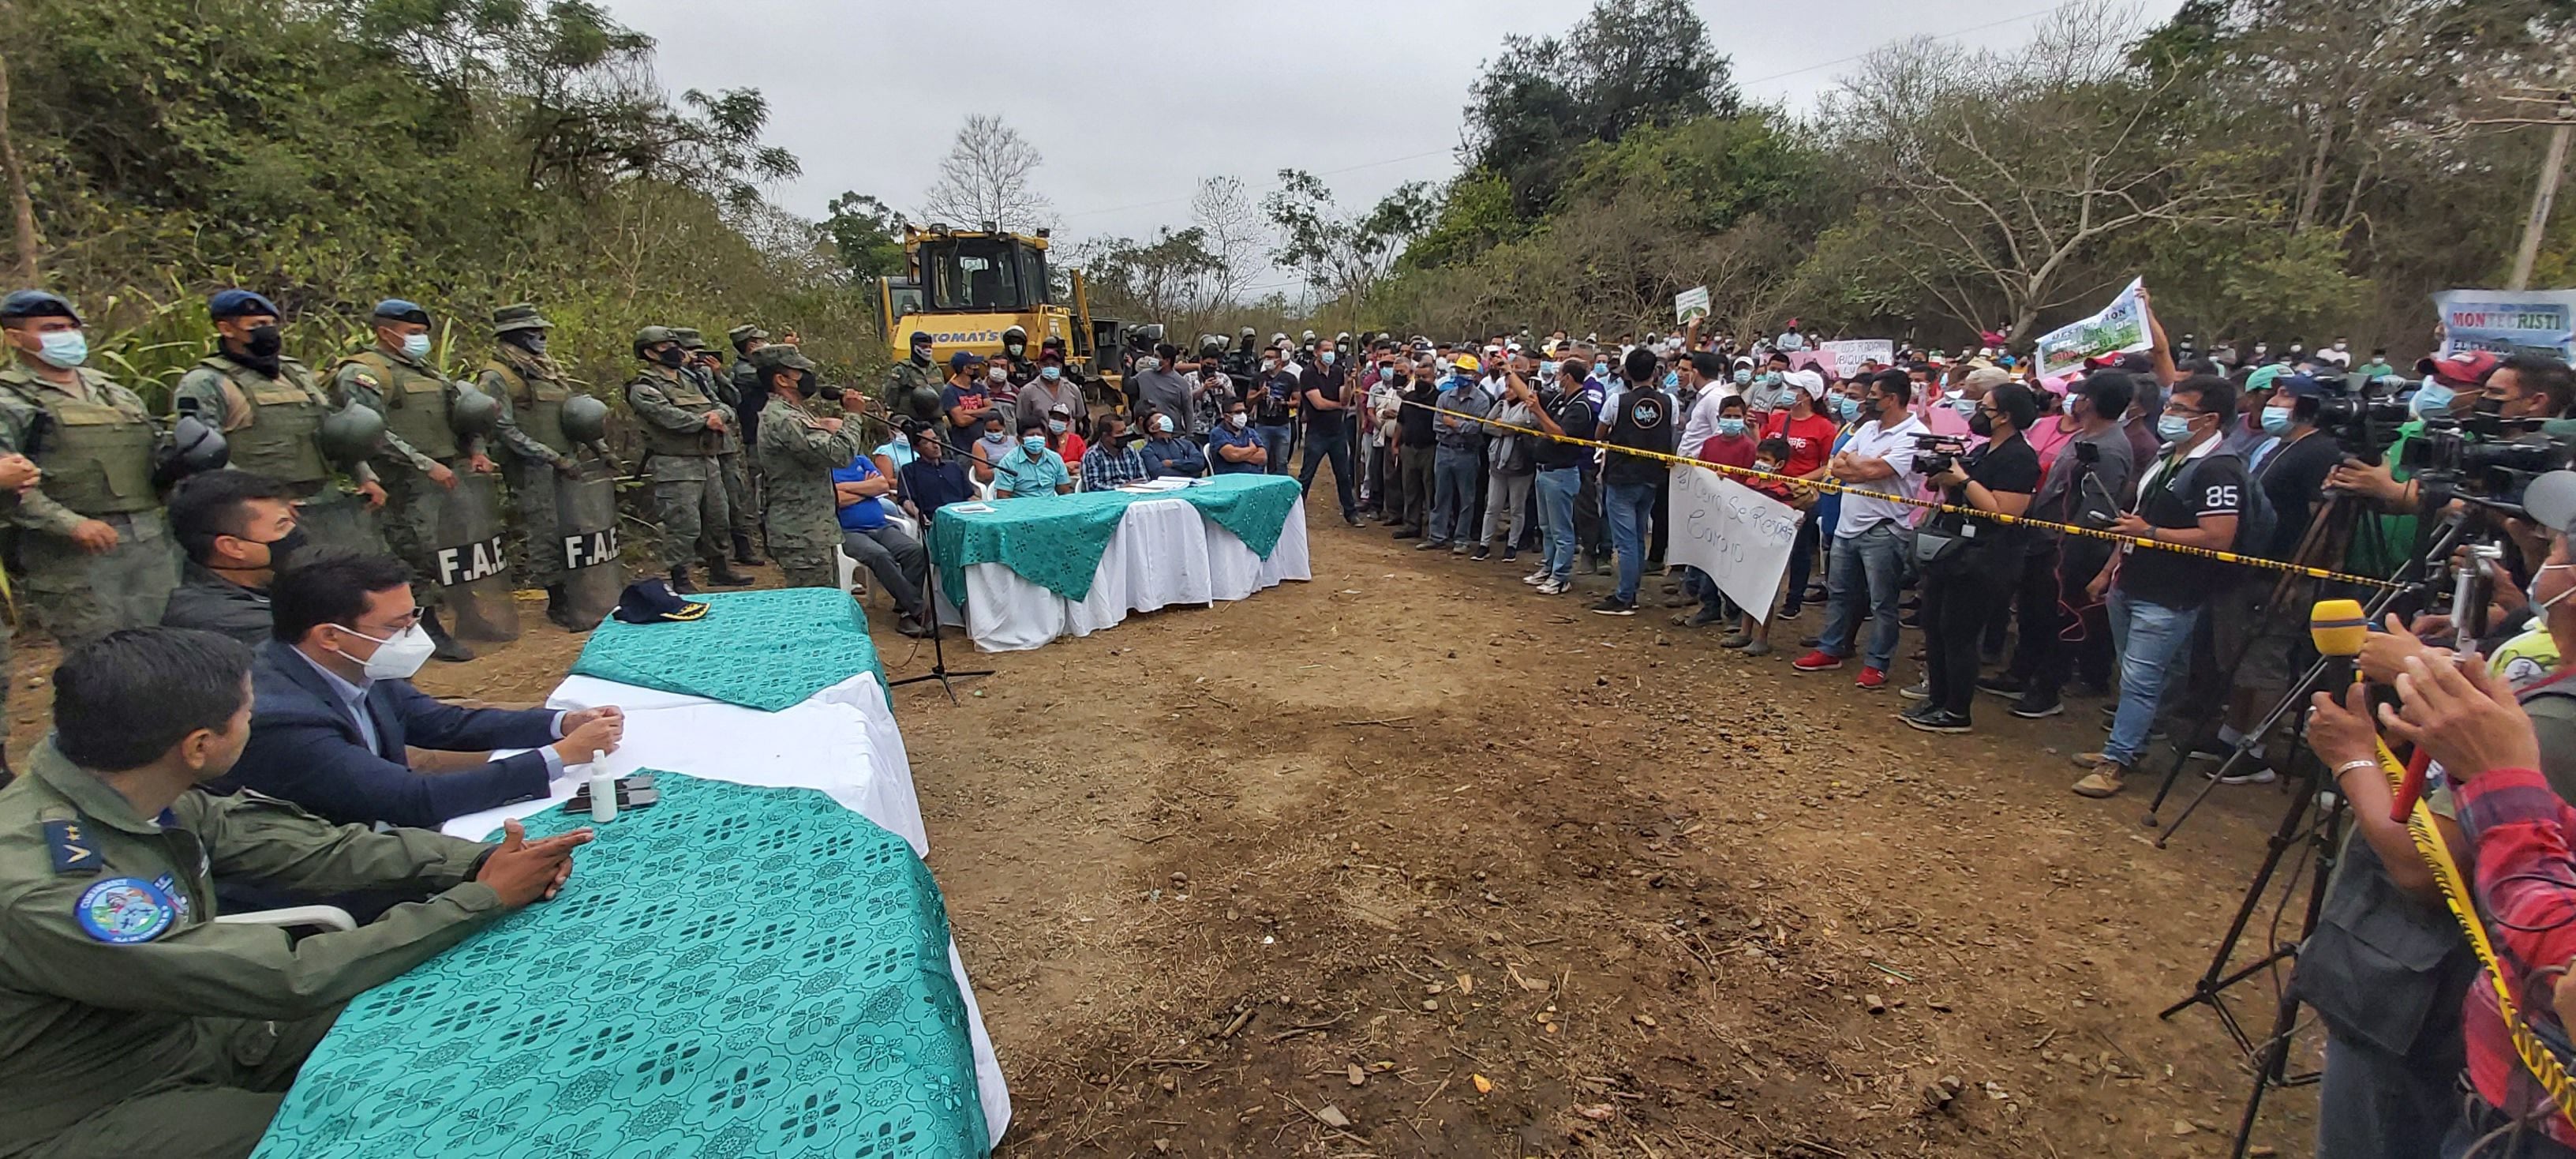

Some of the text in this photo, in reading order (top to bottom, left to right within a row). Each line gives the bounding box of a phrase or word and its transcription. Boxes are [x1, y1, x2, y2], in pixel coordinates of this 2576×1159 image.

[2052, 307, 2126, 339] DESTRUION
[2452, 312, 2560, 330] MONTECRISTI
[931, 330, 1004, 343] KOMATS
[1844, 366, 1855, 375] LU
[2206, 485, 2238, 507] 85
[1728, 496, 1747, 523] Se
